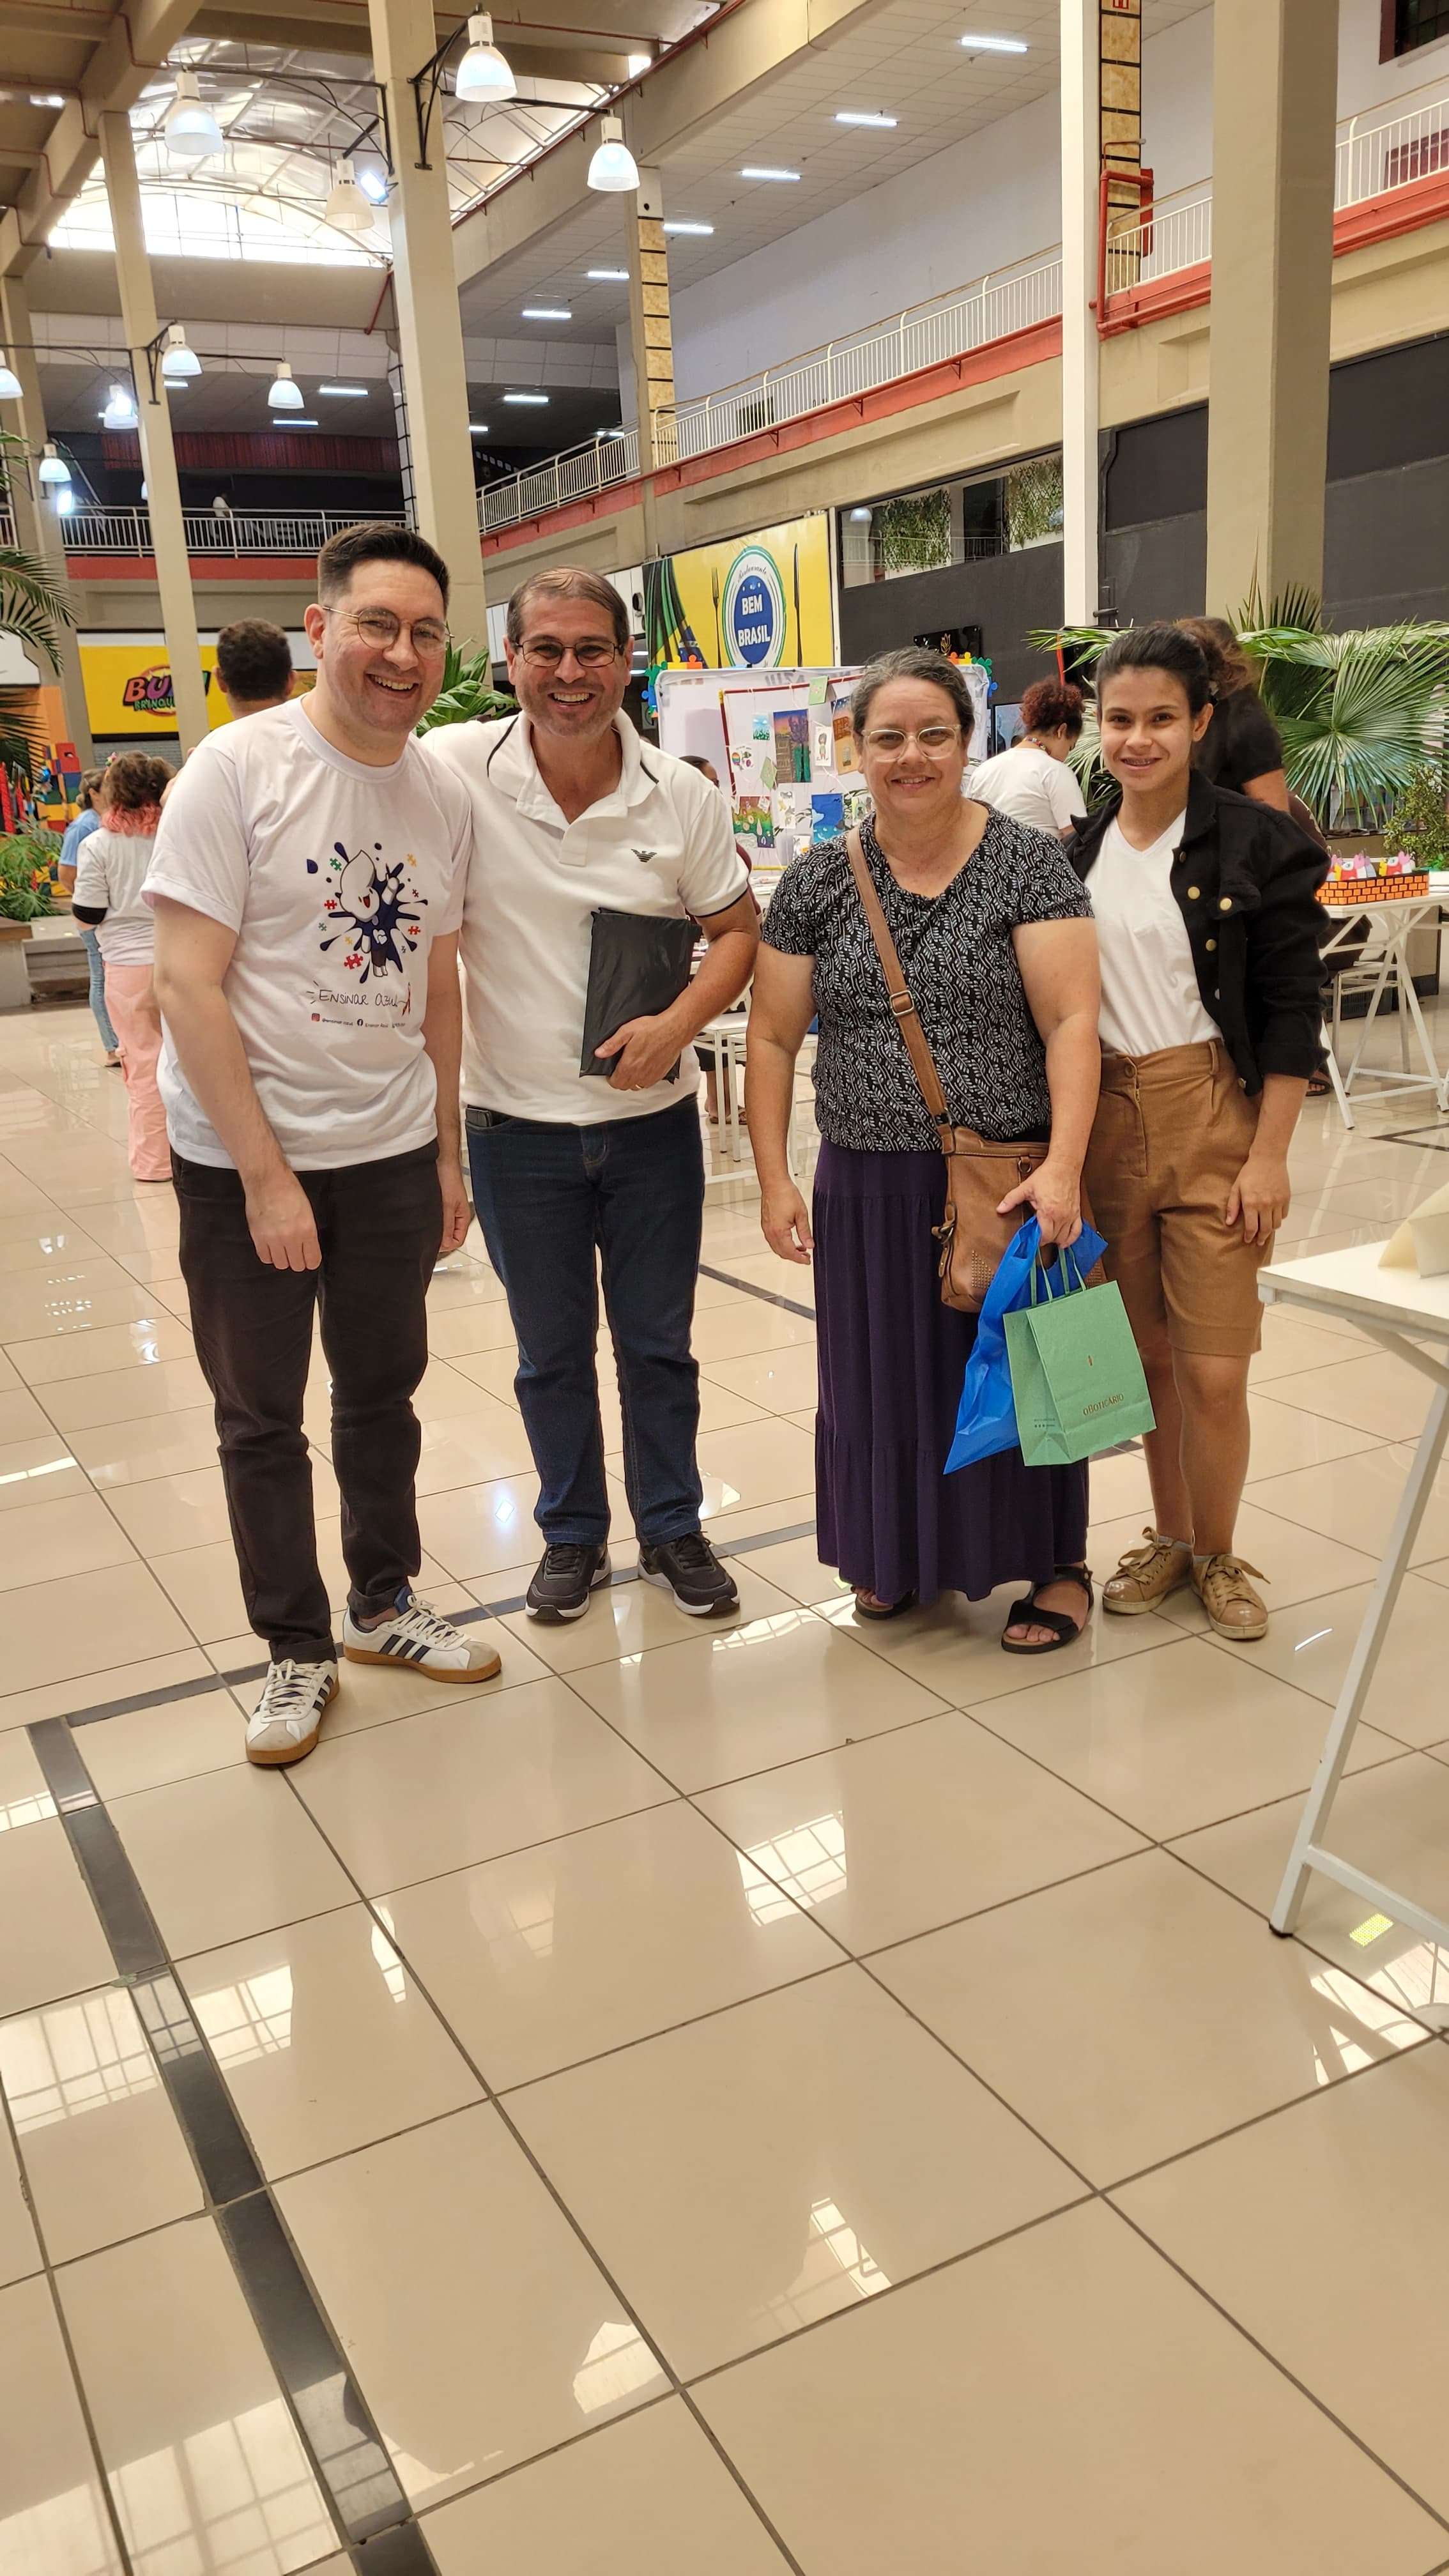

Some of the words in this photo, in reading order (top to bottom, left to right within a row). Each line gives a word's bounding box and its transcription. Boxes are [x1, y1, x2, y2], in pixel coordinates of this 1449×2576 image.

[741, 594, 763, 615] BEM
[738, 624, 770, 647] BRASIL
[134, 698, 175, 711] BRINQU
